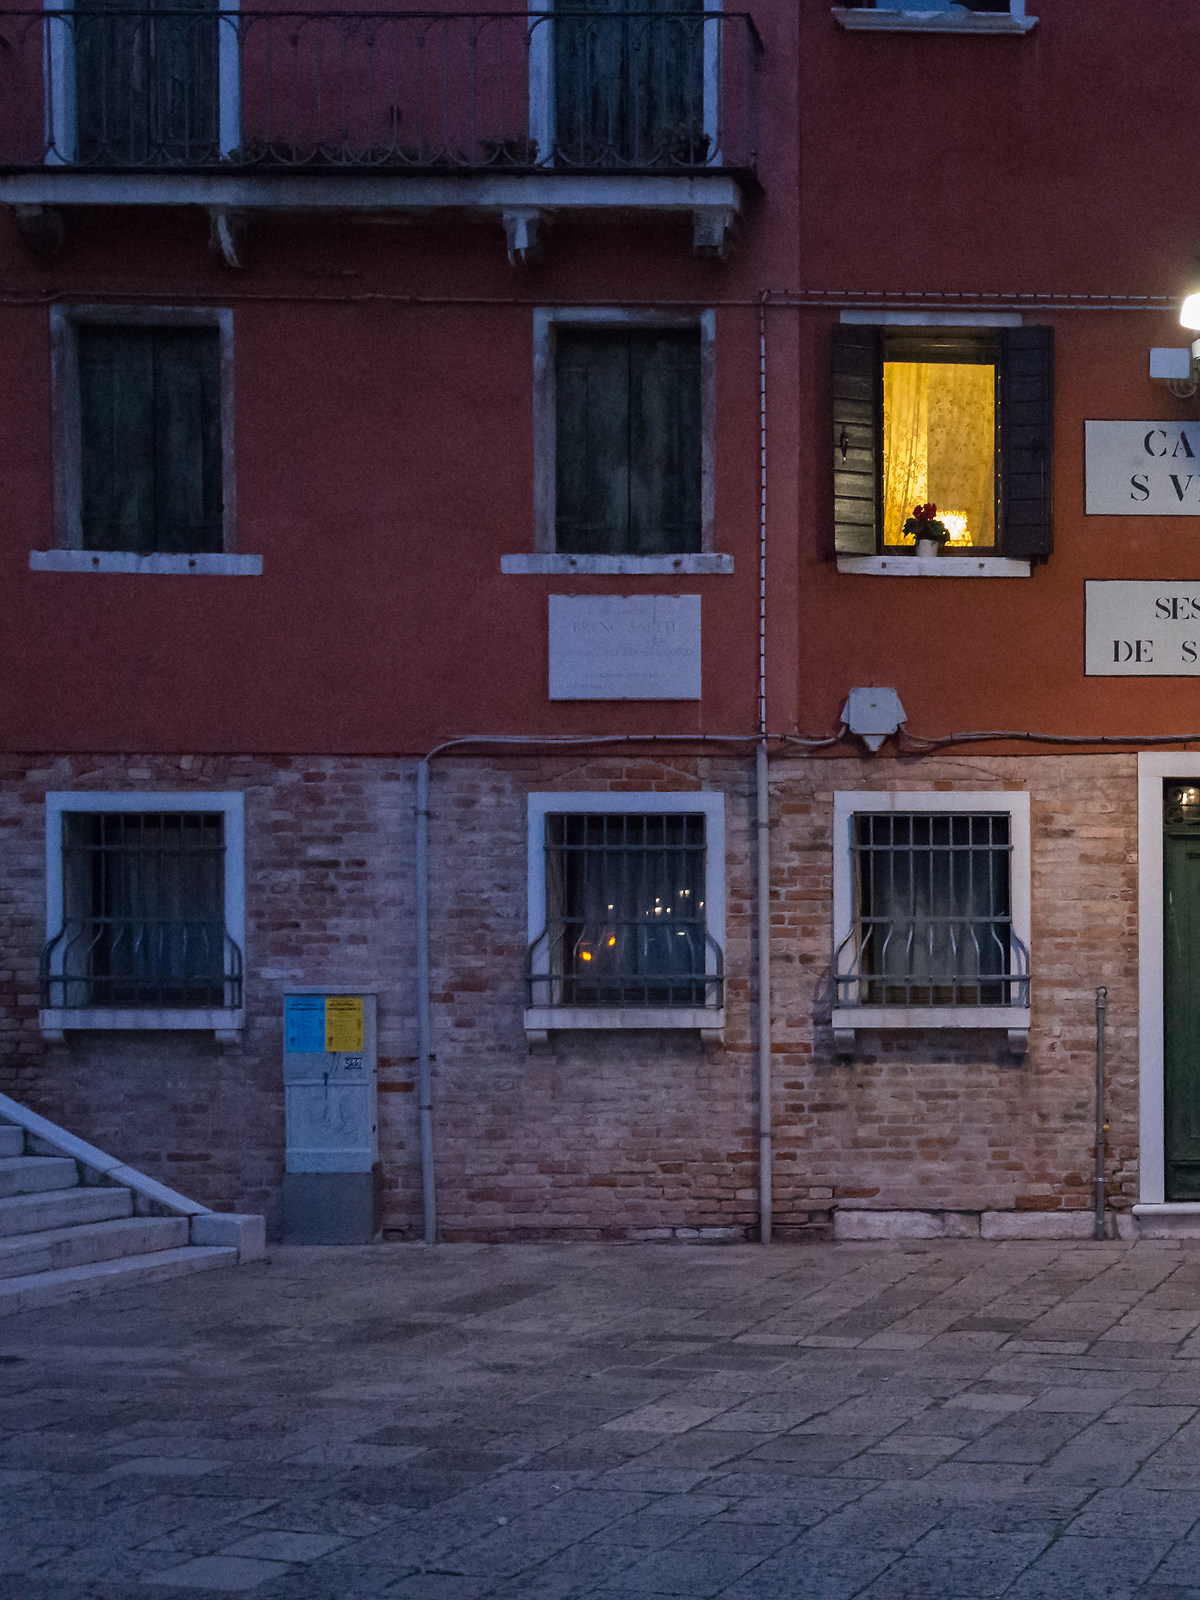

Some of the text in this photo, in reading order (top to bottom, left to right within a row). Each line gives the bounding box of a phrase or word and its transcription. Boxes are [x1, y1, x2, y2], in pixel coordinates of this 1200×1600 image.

[1130, 473, 1151, 502] S
[1113, 640, 1154, 663] DE
[1181, 641, 1198, 663] S
